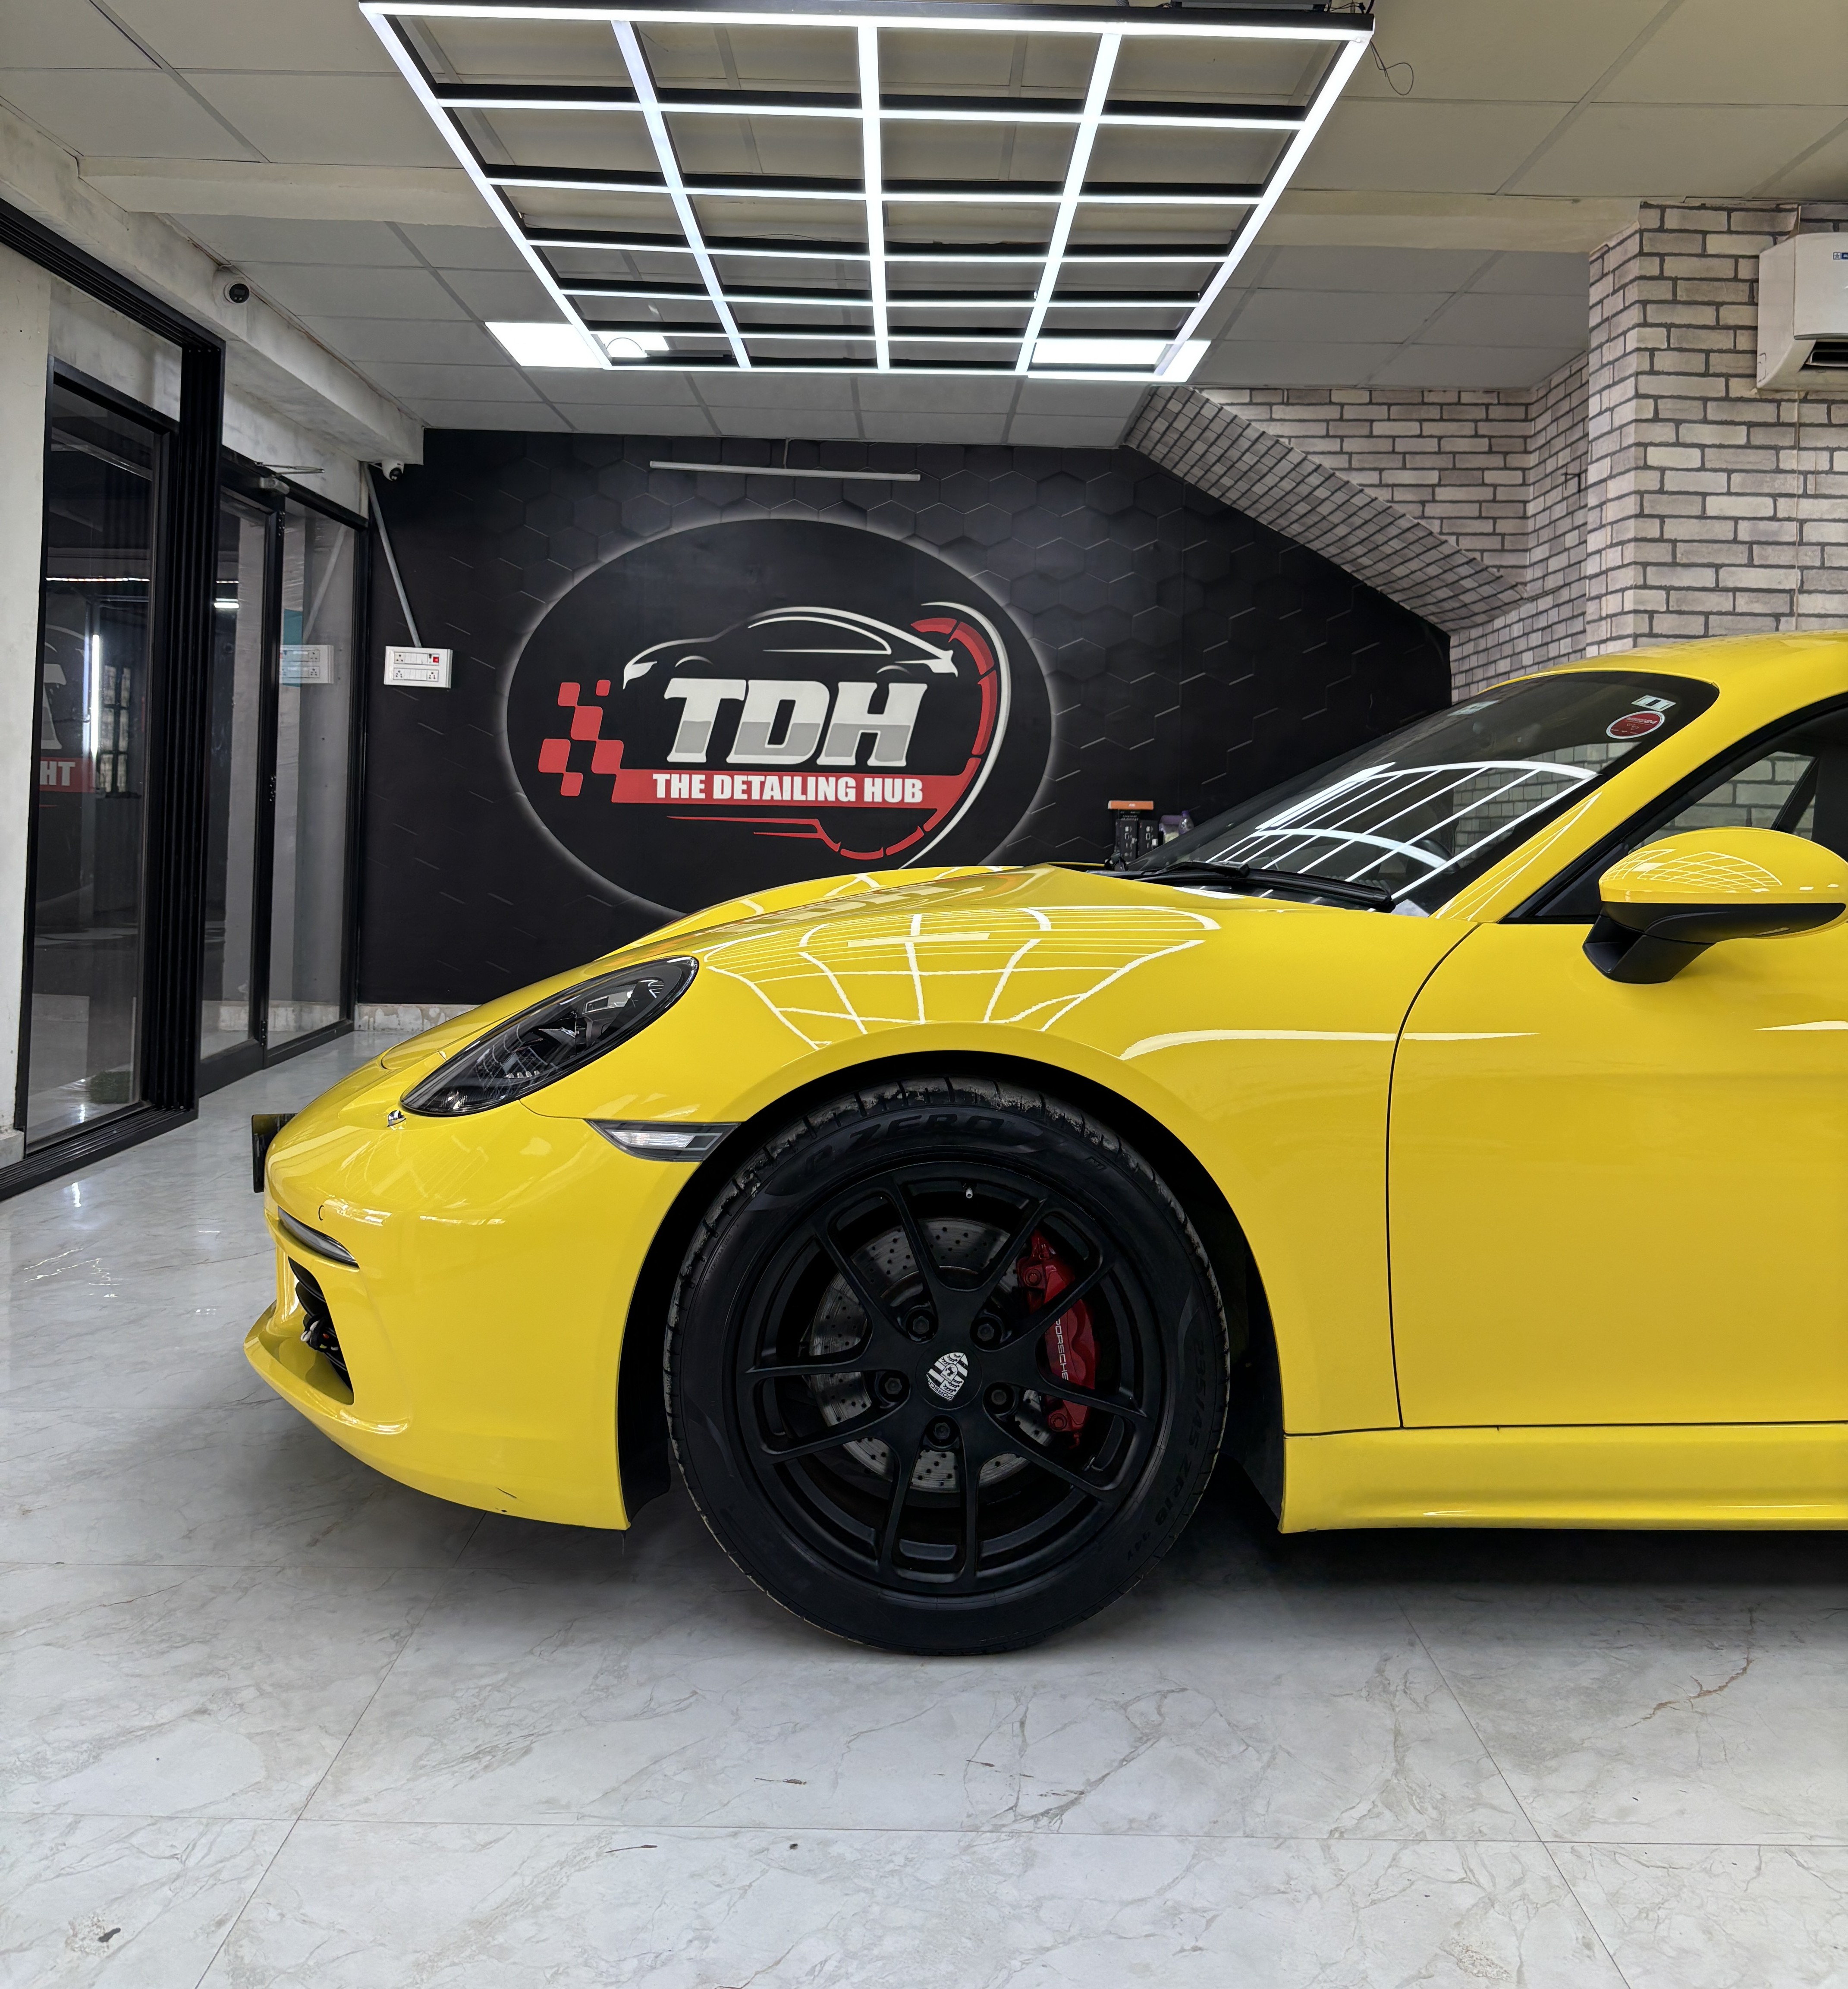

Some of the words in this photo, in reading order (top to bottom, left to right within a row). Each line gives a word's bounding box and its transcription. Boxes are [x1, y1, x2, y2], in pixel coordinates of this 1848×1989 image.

[664, 678, 927, 767] TDH
[653, 774, 705, 799] THE
[713, 774, 856, 802] DETAILING
[864, 777, 923, 803] HUB
[845, 1114, 1004, 1152] ZERO
[1055, 1318, 1069, 1381] PORSCHE
